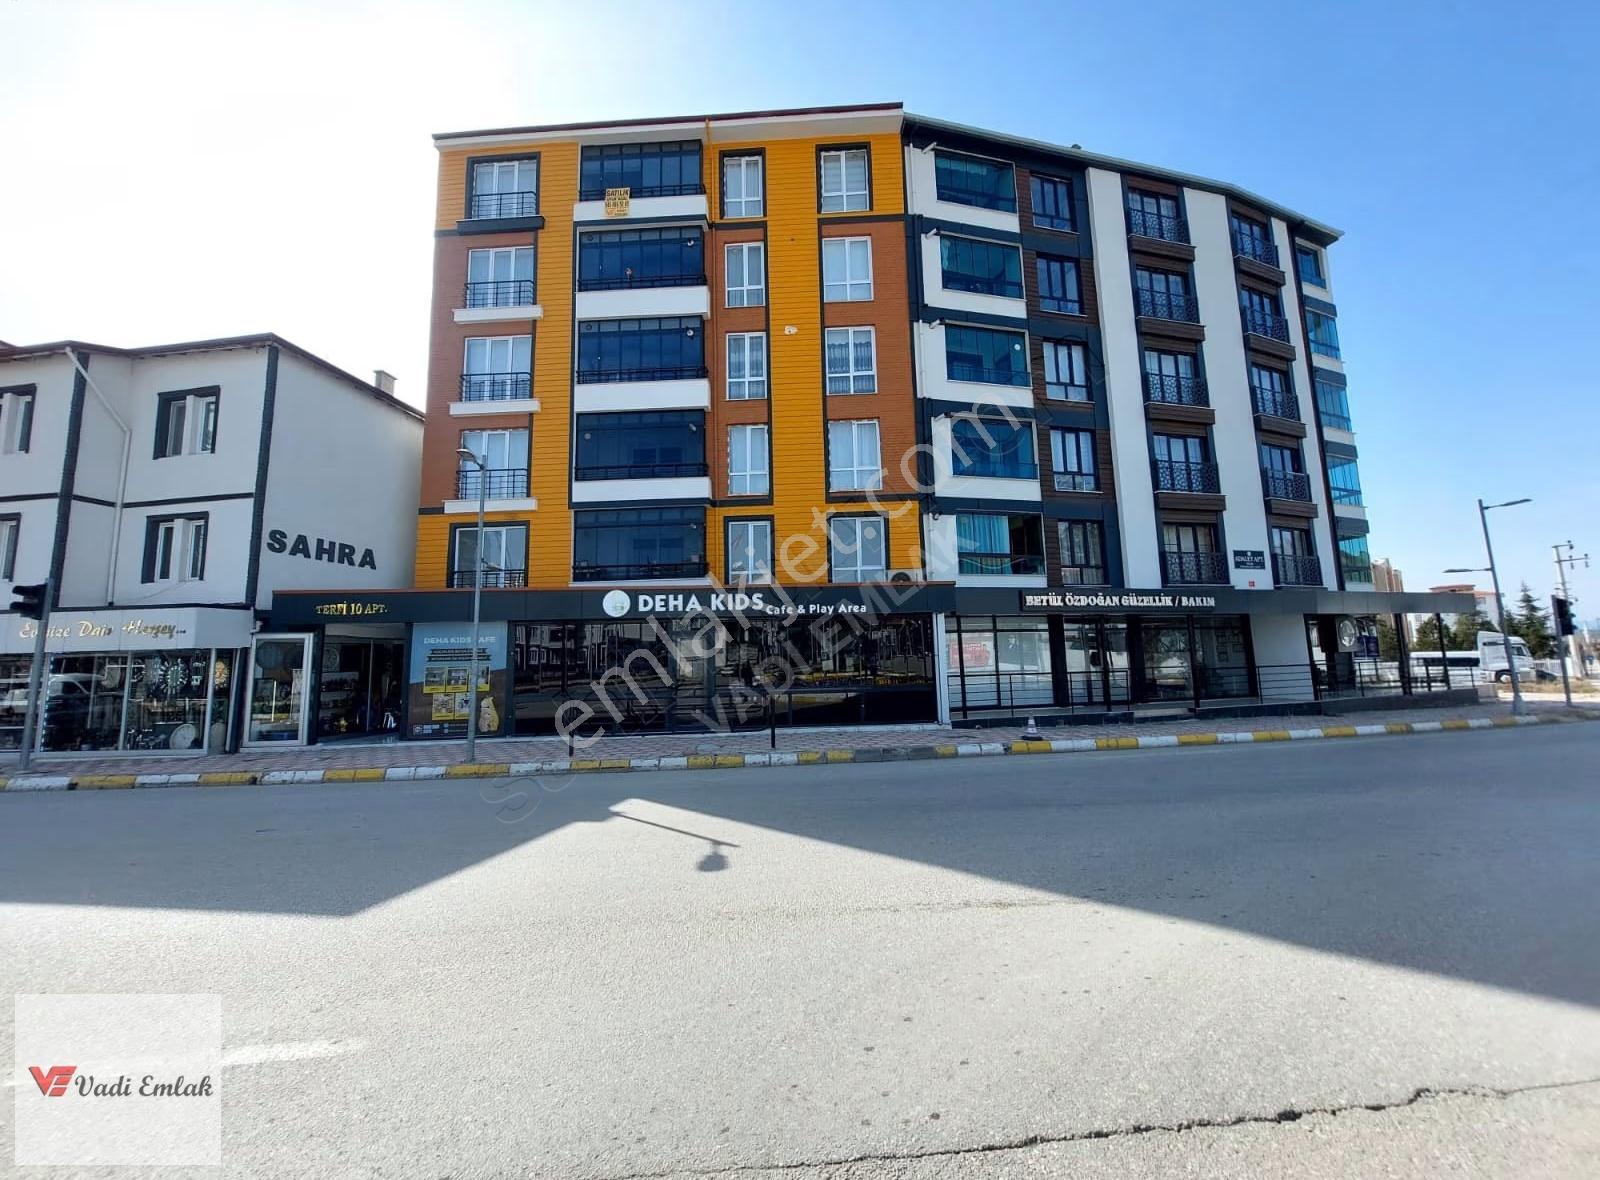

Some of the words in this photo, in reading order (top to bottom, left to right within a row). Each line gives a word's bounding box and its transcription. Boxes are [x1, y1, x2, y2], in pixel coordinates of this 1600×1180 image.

[266, 529, 376, 570] SAHRA
[638, 593, 702, 612] DEHA
[711, 593, 764, 611] KIDS
[1025, 592, 1063, 606] BETÜL
[1065, 592, 1120, 606] ÖZDOĞAN
[1121, 593, 1173, 606] GÜZELLİK
[1181, 596, 1215, 607] BAKIM
[351, 603, 362, 615] 10
[364, 603, 387, 614] APT.
[766, 604, 794, 615] Cafe
[797, 604, 806, 614] &
[809, 603, 835, 616] Play
[838, 603, 868, 613] Area
[19, 622, 71, 638] Evize
[477, 636, 497, 644] AFE
